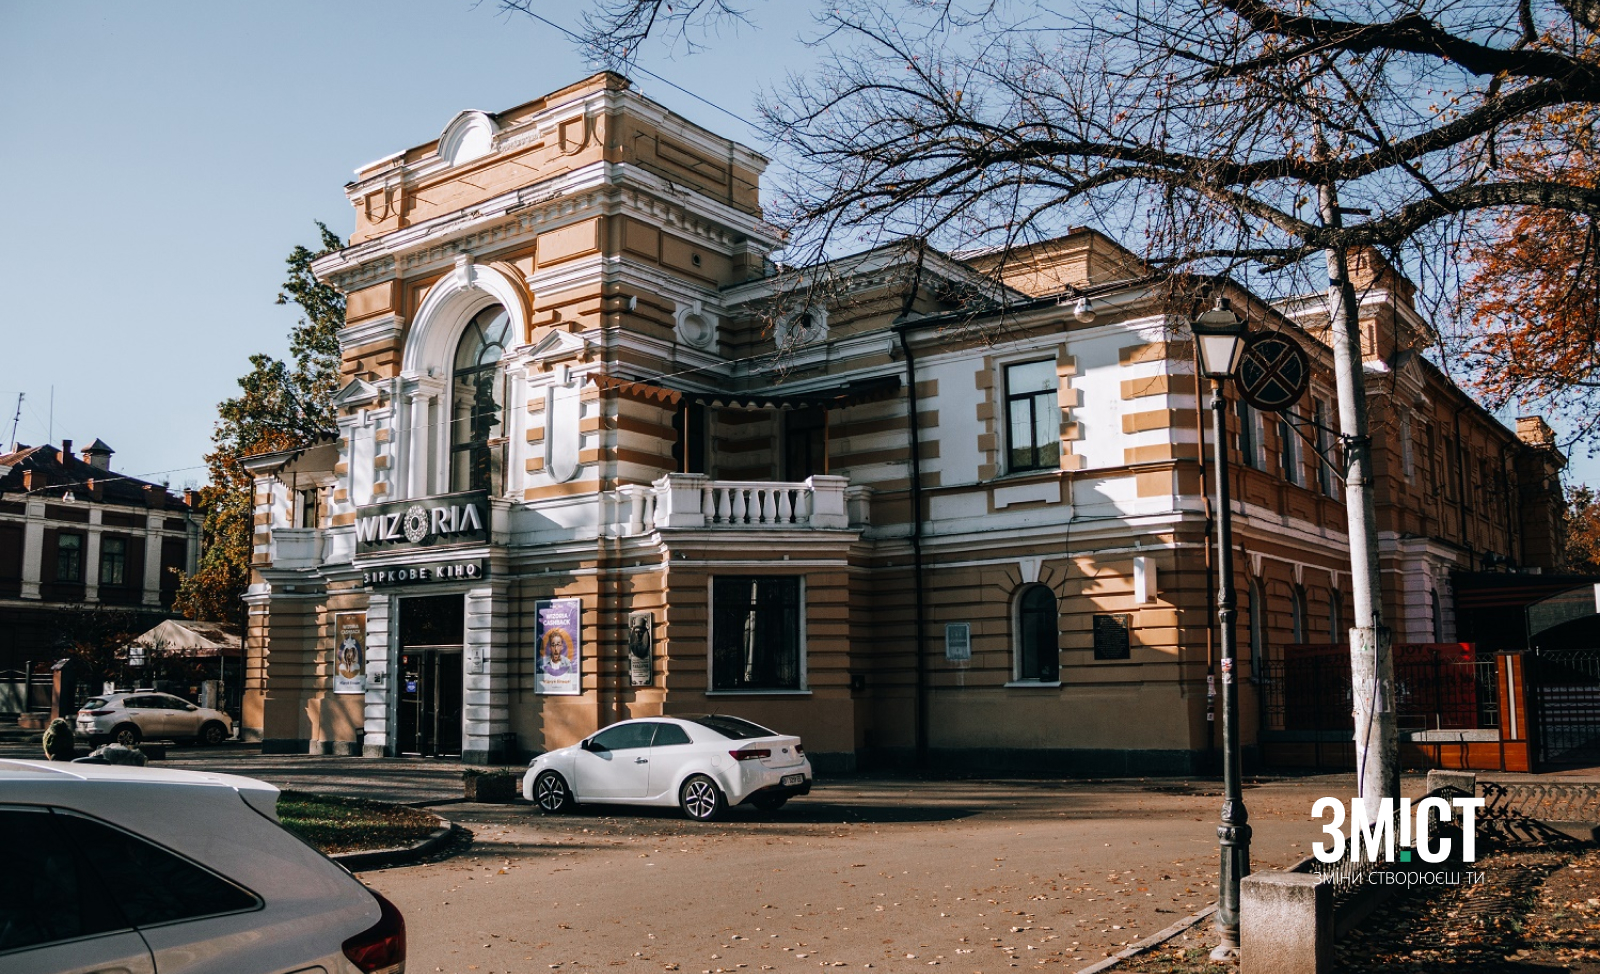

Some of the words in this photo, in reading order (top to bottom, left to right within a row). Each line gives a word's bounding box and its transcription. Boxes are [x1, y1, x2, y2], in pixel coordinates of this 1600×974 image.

[354, 503, 482, 543] WIZORIA
[363, 567, 428, 583] ЗІРКОВЕ
[436, 563, 475, 578] КІНО
